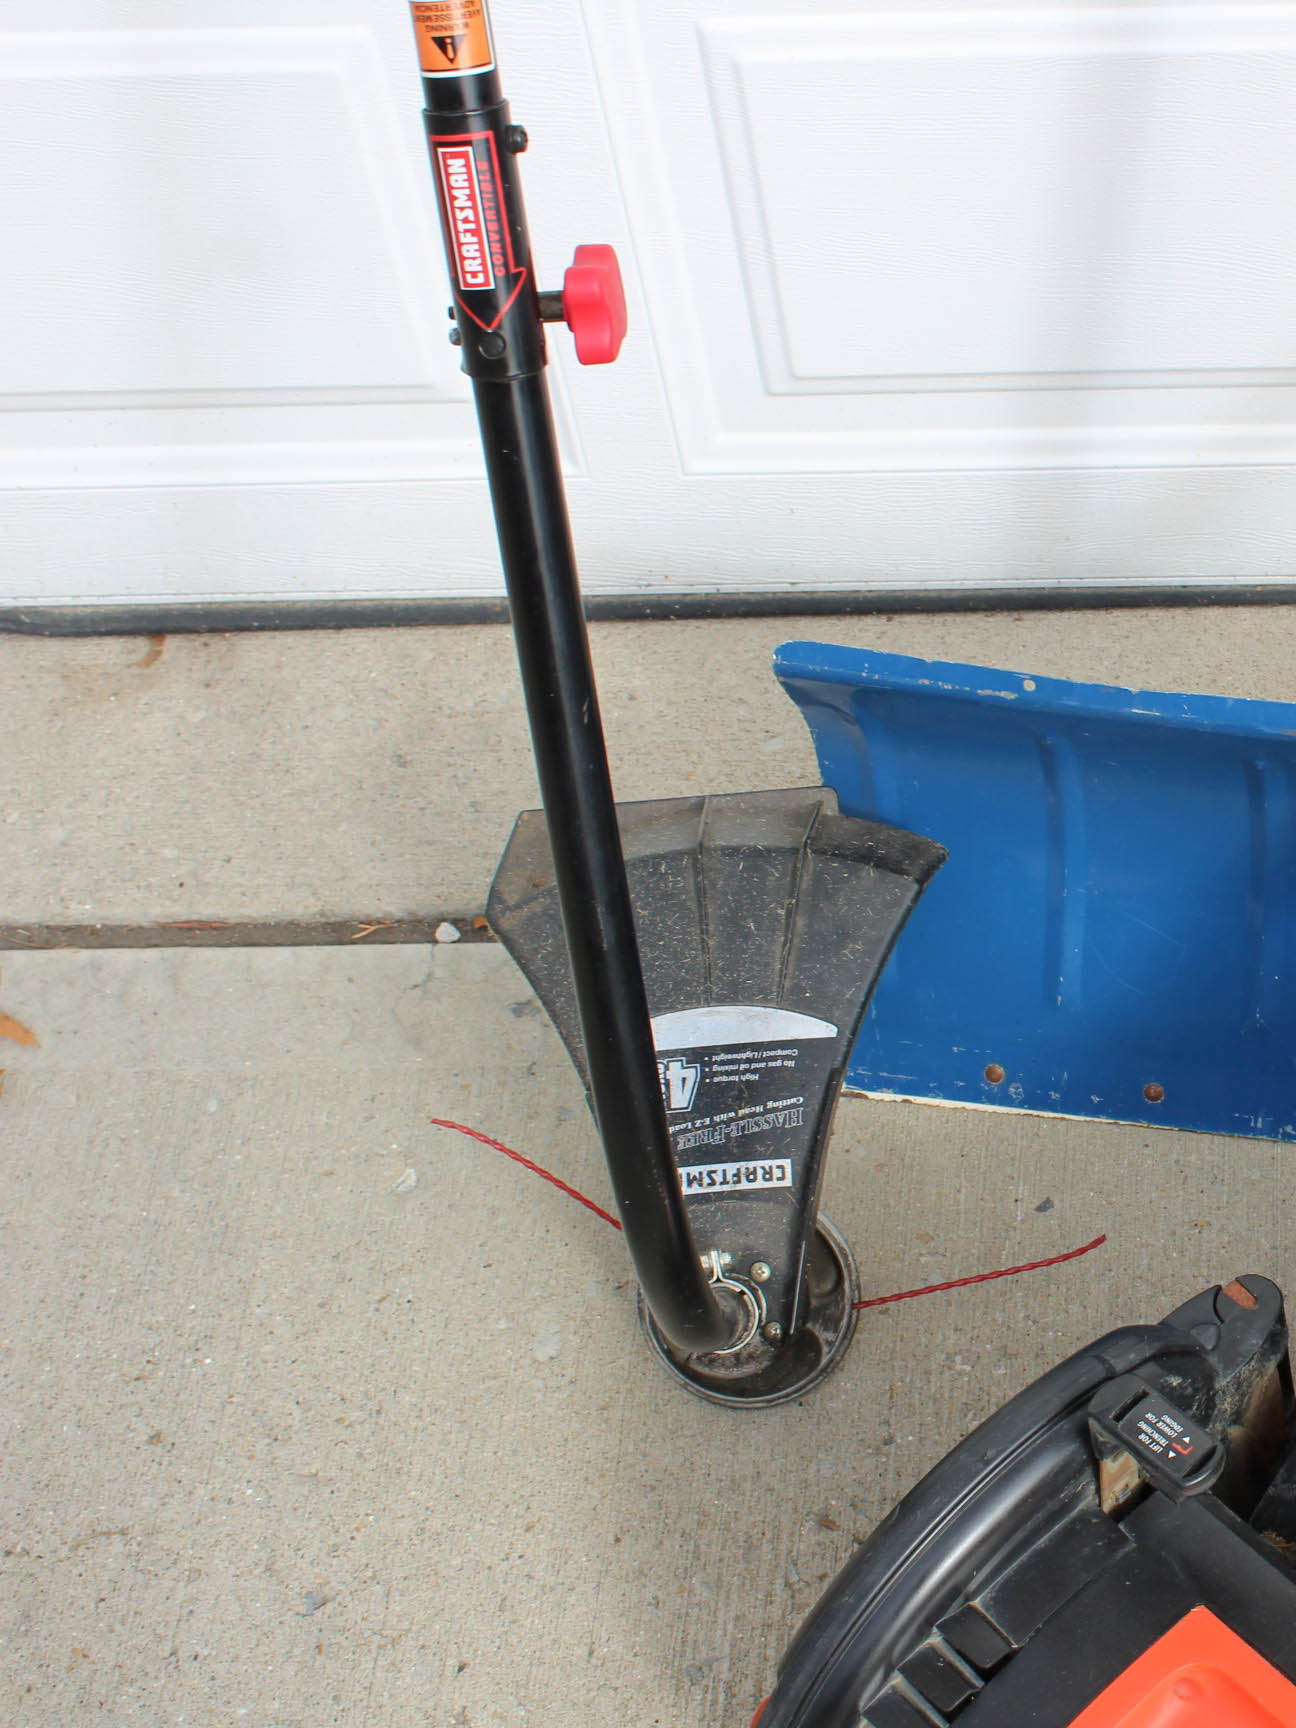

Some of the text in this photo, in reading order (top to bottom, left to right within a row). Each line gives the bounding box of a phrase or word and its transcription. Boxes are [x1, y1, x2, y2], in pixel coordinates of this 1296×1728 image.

[447, 158, 486, 285] CRAFTSMAN
[476, 160, 506, 276] CONVERTIBLE
[712, 1064, 739, 1072] mixing
[739, 1063, 750, 1071] oil
[751, 1062, 767, 1070] and
[767, 1059, 783, 1067] gas
[713, 1073, 759, 1083] High torque
[766, 1096, 804, 1109] Cutting
[713, 1111, 737, 1122] with
[737, 1104, 764, 1117] Head
[668, 1122, 693, 1134] Load
[677, 1107, 805, 1150] HASSLE-FREE
[680, 1164, 786, 1188] CRAFTSM
[1144, 1412, 1178, 1438] LOWER FOR
[1161, 1414, 1184, 1433] EDGING
[1137, 1421, 1169, 1447] TRENCHING
[1138, 1432, 1164, 1454] LIFT FOR
